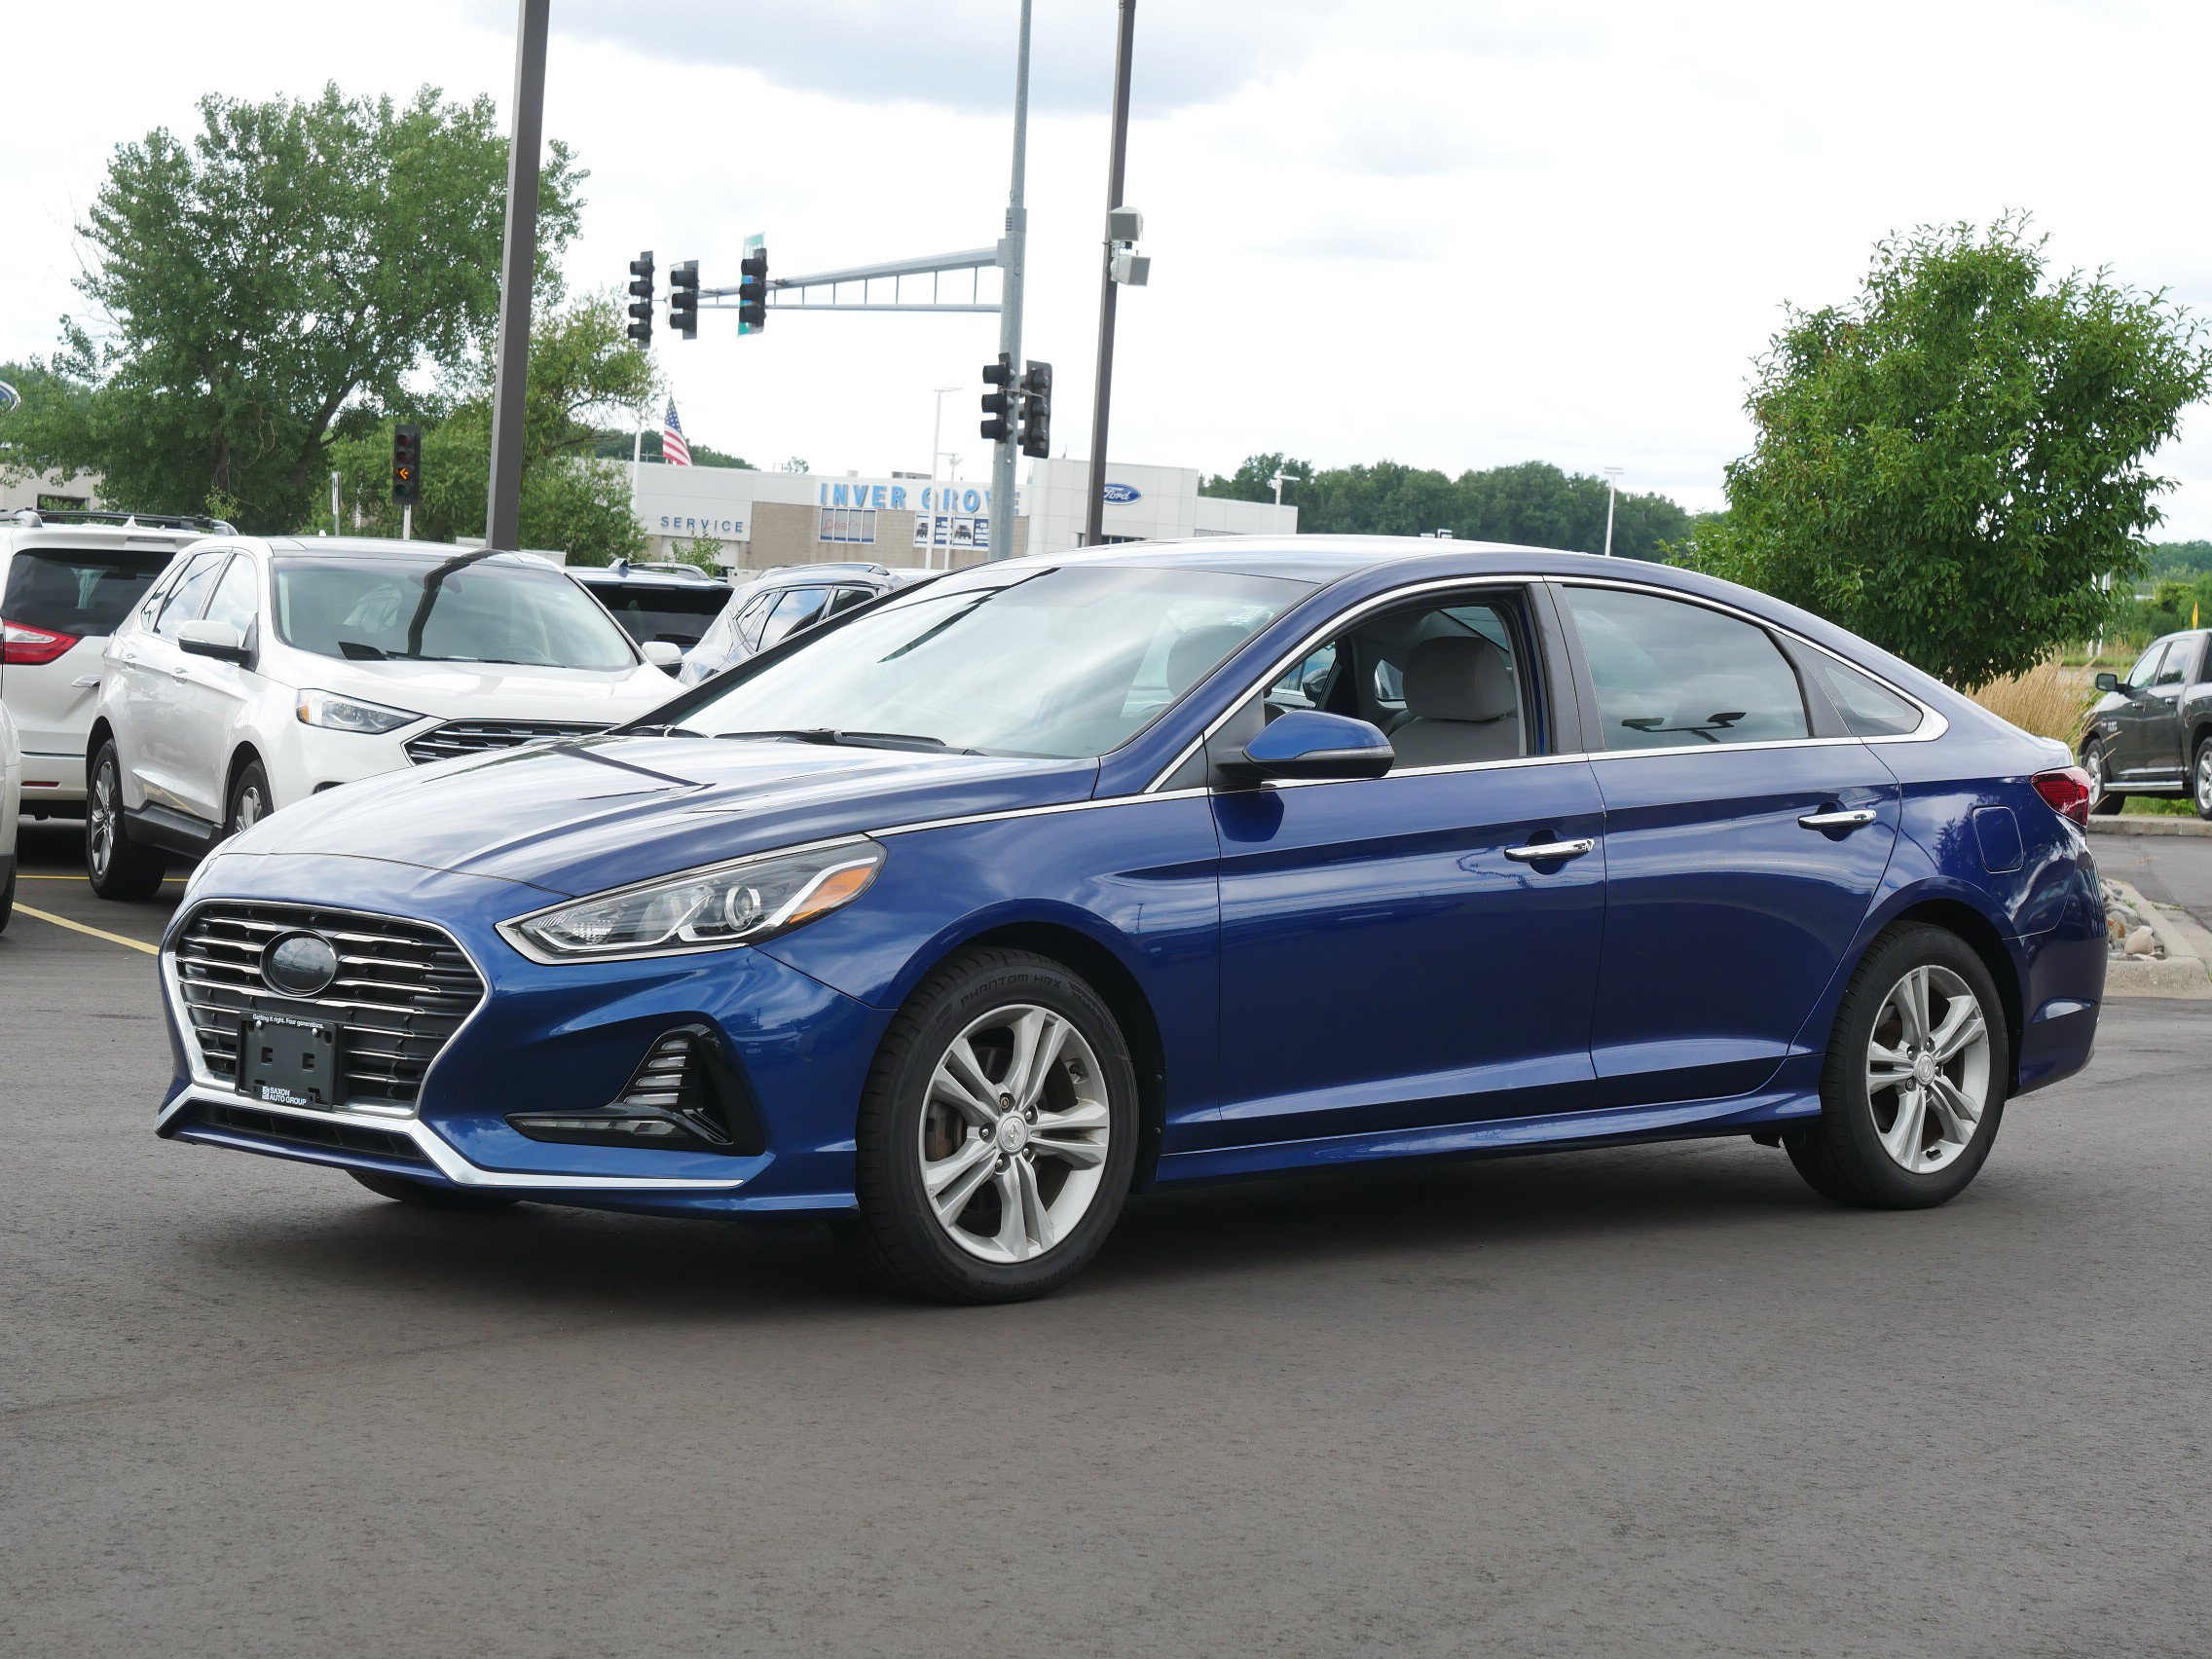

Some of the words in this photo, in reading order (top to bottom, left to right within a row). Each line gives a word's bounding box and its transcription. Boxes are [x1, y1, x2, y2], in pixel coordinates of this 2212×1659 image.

[820, 483, 905, 509] INVER
[1103, 486, 1131, 500] Ford
[661, 516, 743, 533] SERVICE
[960, 974, 1029, 1008] PHANTOM
[253, 1014, 269, 1022] Getting
[270, 1087, 290, 1097] SAXON
[270, 1093, 285, 1103] AUTO
[285, 1096, 307, 1106] GROUP
